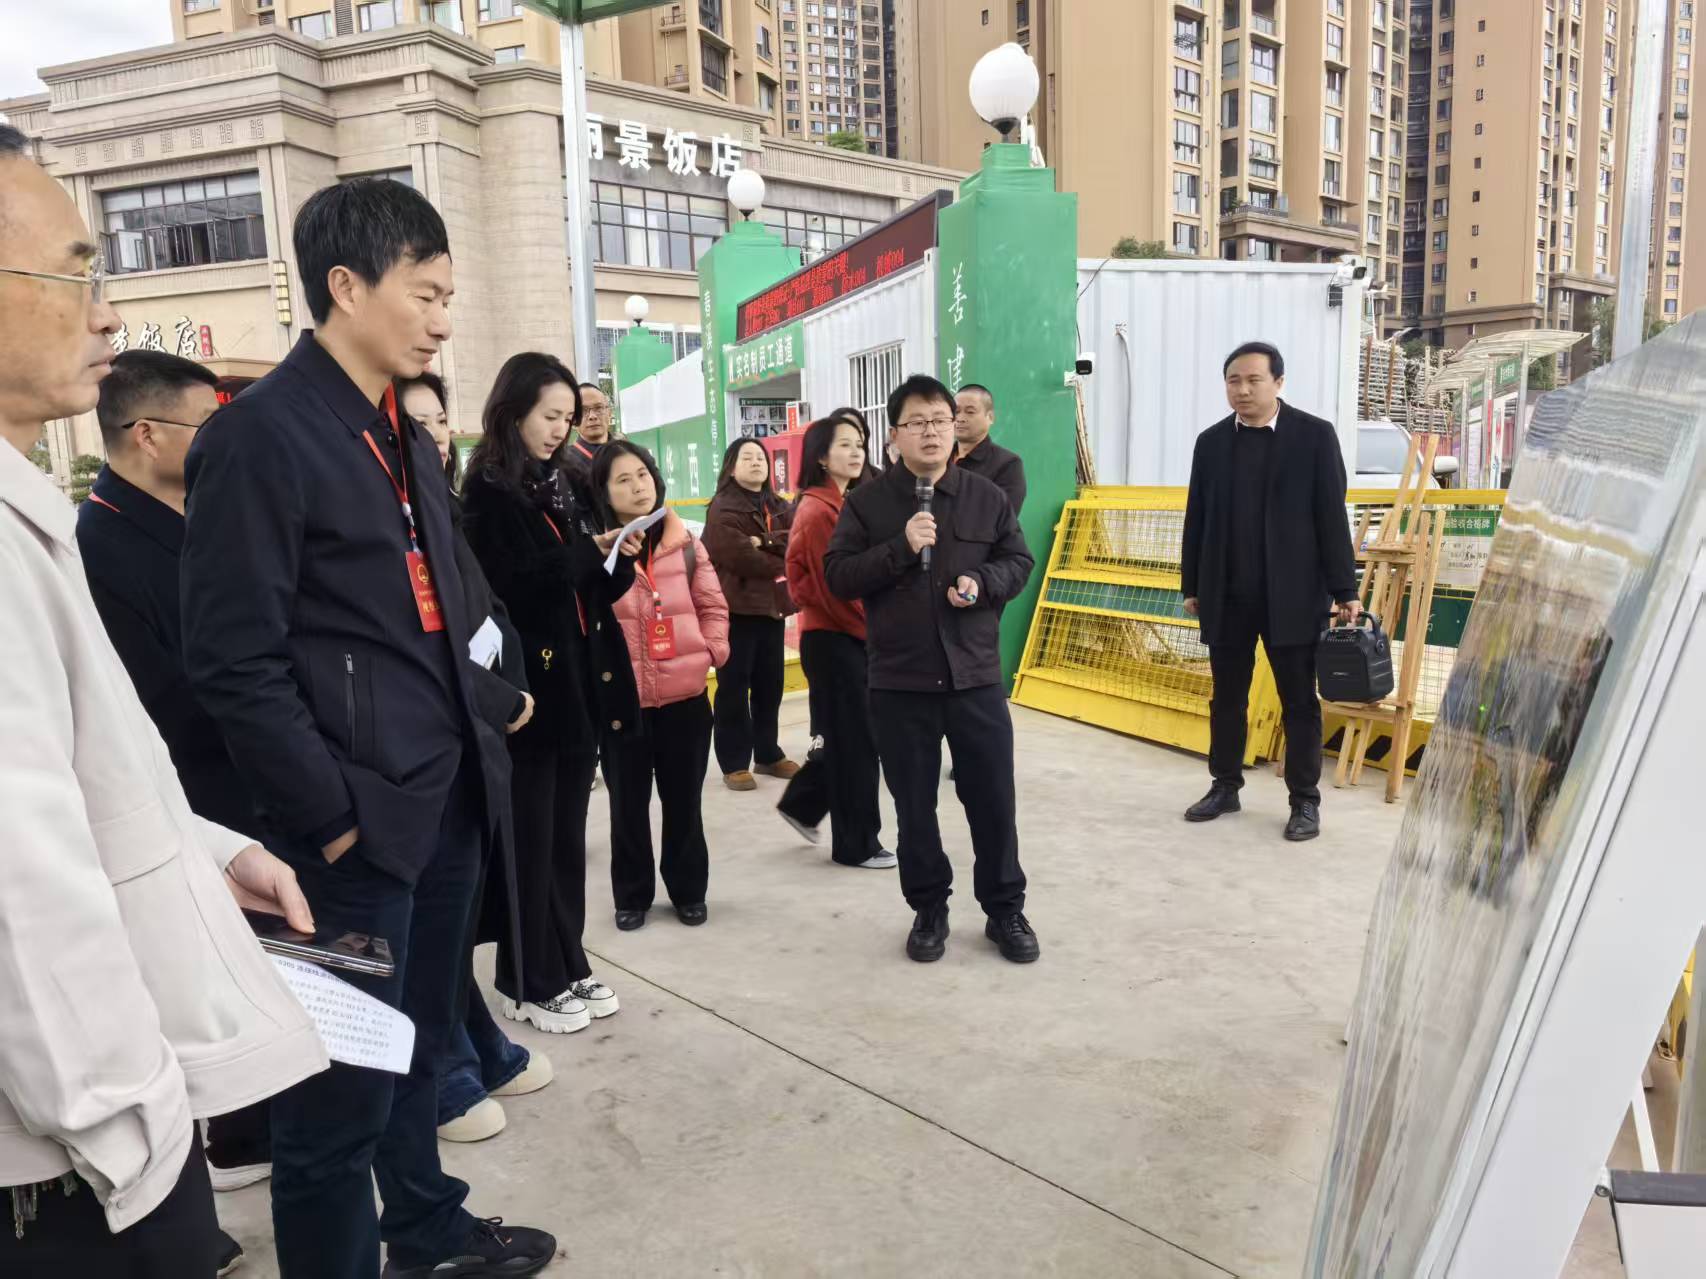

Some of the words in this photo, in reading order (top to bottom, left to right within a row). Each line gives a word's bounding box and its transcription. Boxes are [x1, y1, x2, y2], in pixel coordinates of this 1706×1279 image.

[736, 335, 793, 379] 实名制员工通道
